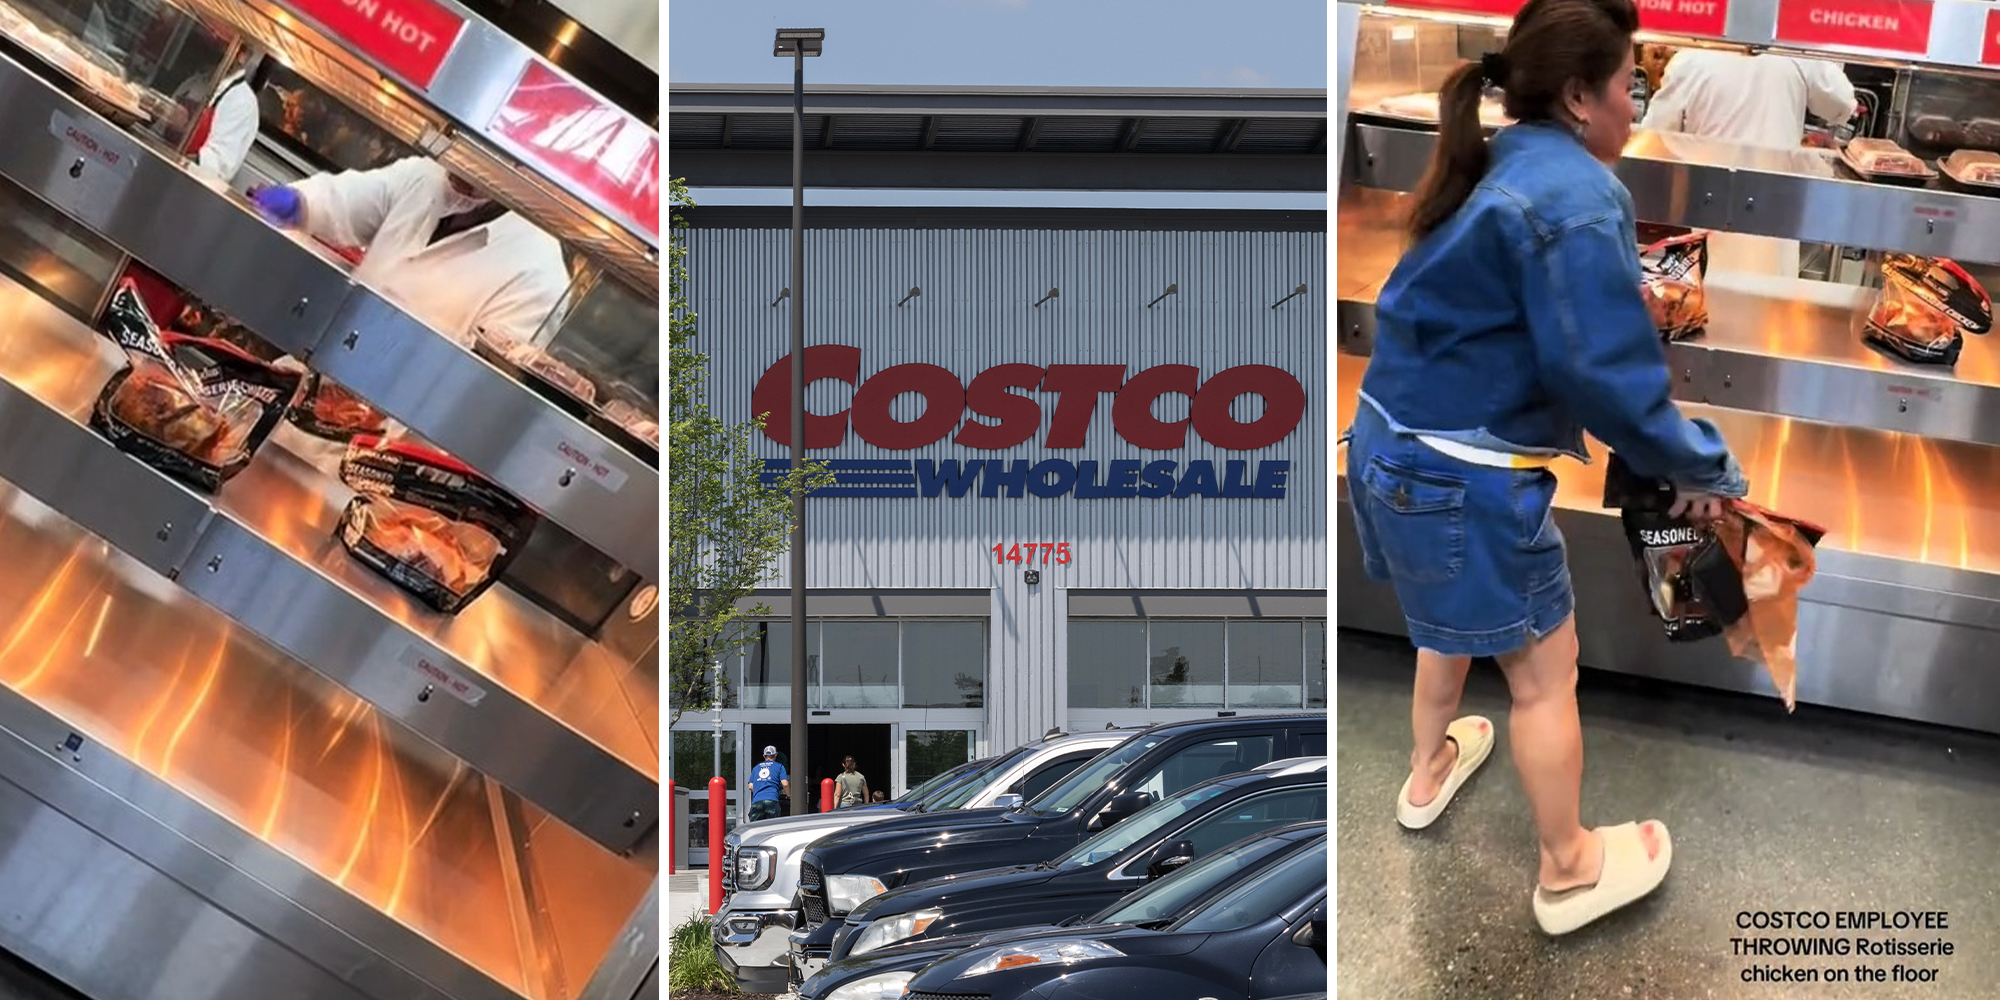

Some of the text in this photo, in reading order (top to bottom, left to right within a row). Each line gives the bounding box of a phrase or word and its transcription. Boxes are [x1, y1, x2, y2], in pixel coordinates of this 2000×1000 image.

[1677, 1, 1717, 15] HOT
[1809, 8, 1899, 32] CHICKEN
[381, 9, 437, 53] HOT
[66, 126, 98, 152] CAUTION
[103, 149, 120, 164] HOT
[752, 344, 1306, 451] COSTCO
[558, 441, 589, 467] CAUTION
[593, 463, 610, 478] HOT
[915, 458, 1291, 499] WHOLESALE
[992, 542, 1071, 565] 14775
